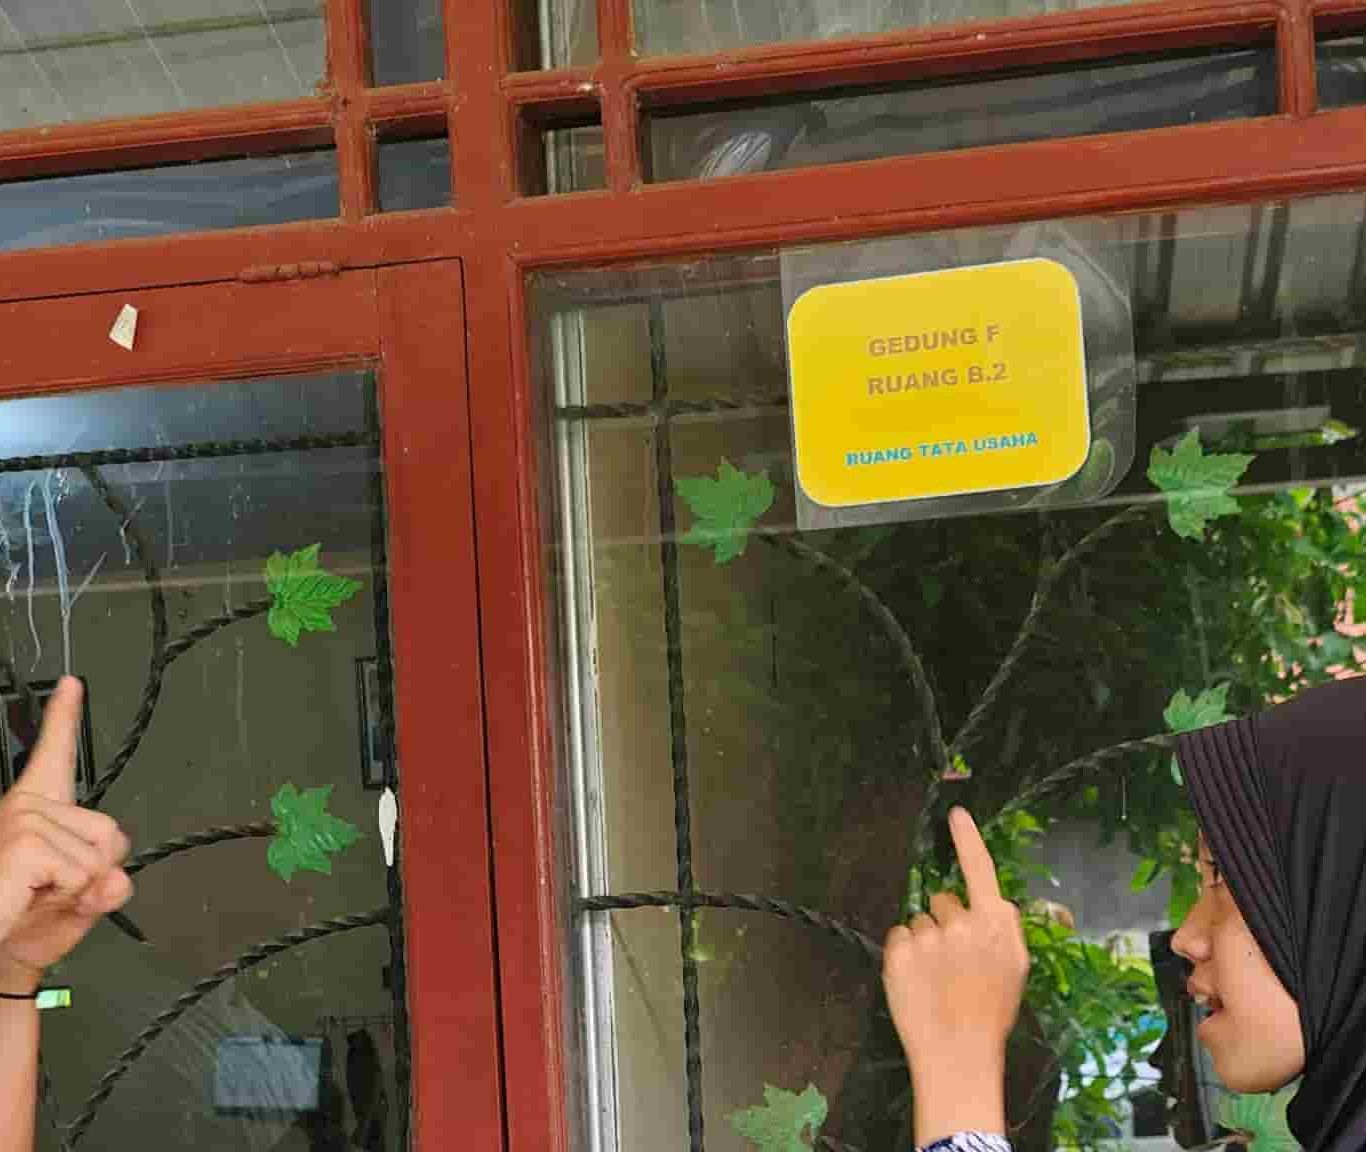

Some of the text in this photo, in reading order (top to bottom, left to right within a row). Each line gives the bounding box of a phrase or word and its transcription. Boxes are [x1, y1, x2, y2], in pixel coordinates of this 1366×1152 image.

[868, 324, 1003, 357] GEDUNG F
[867, 362, 1008, 396] RUANG B.2
[845, 431, 1039, 467] RUANG TATA USAHA
